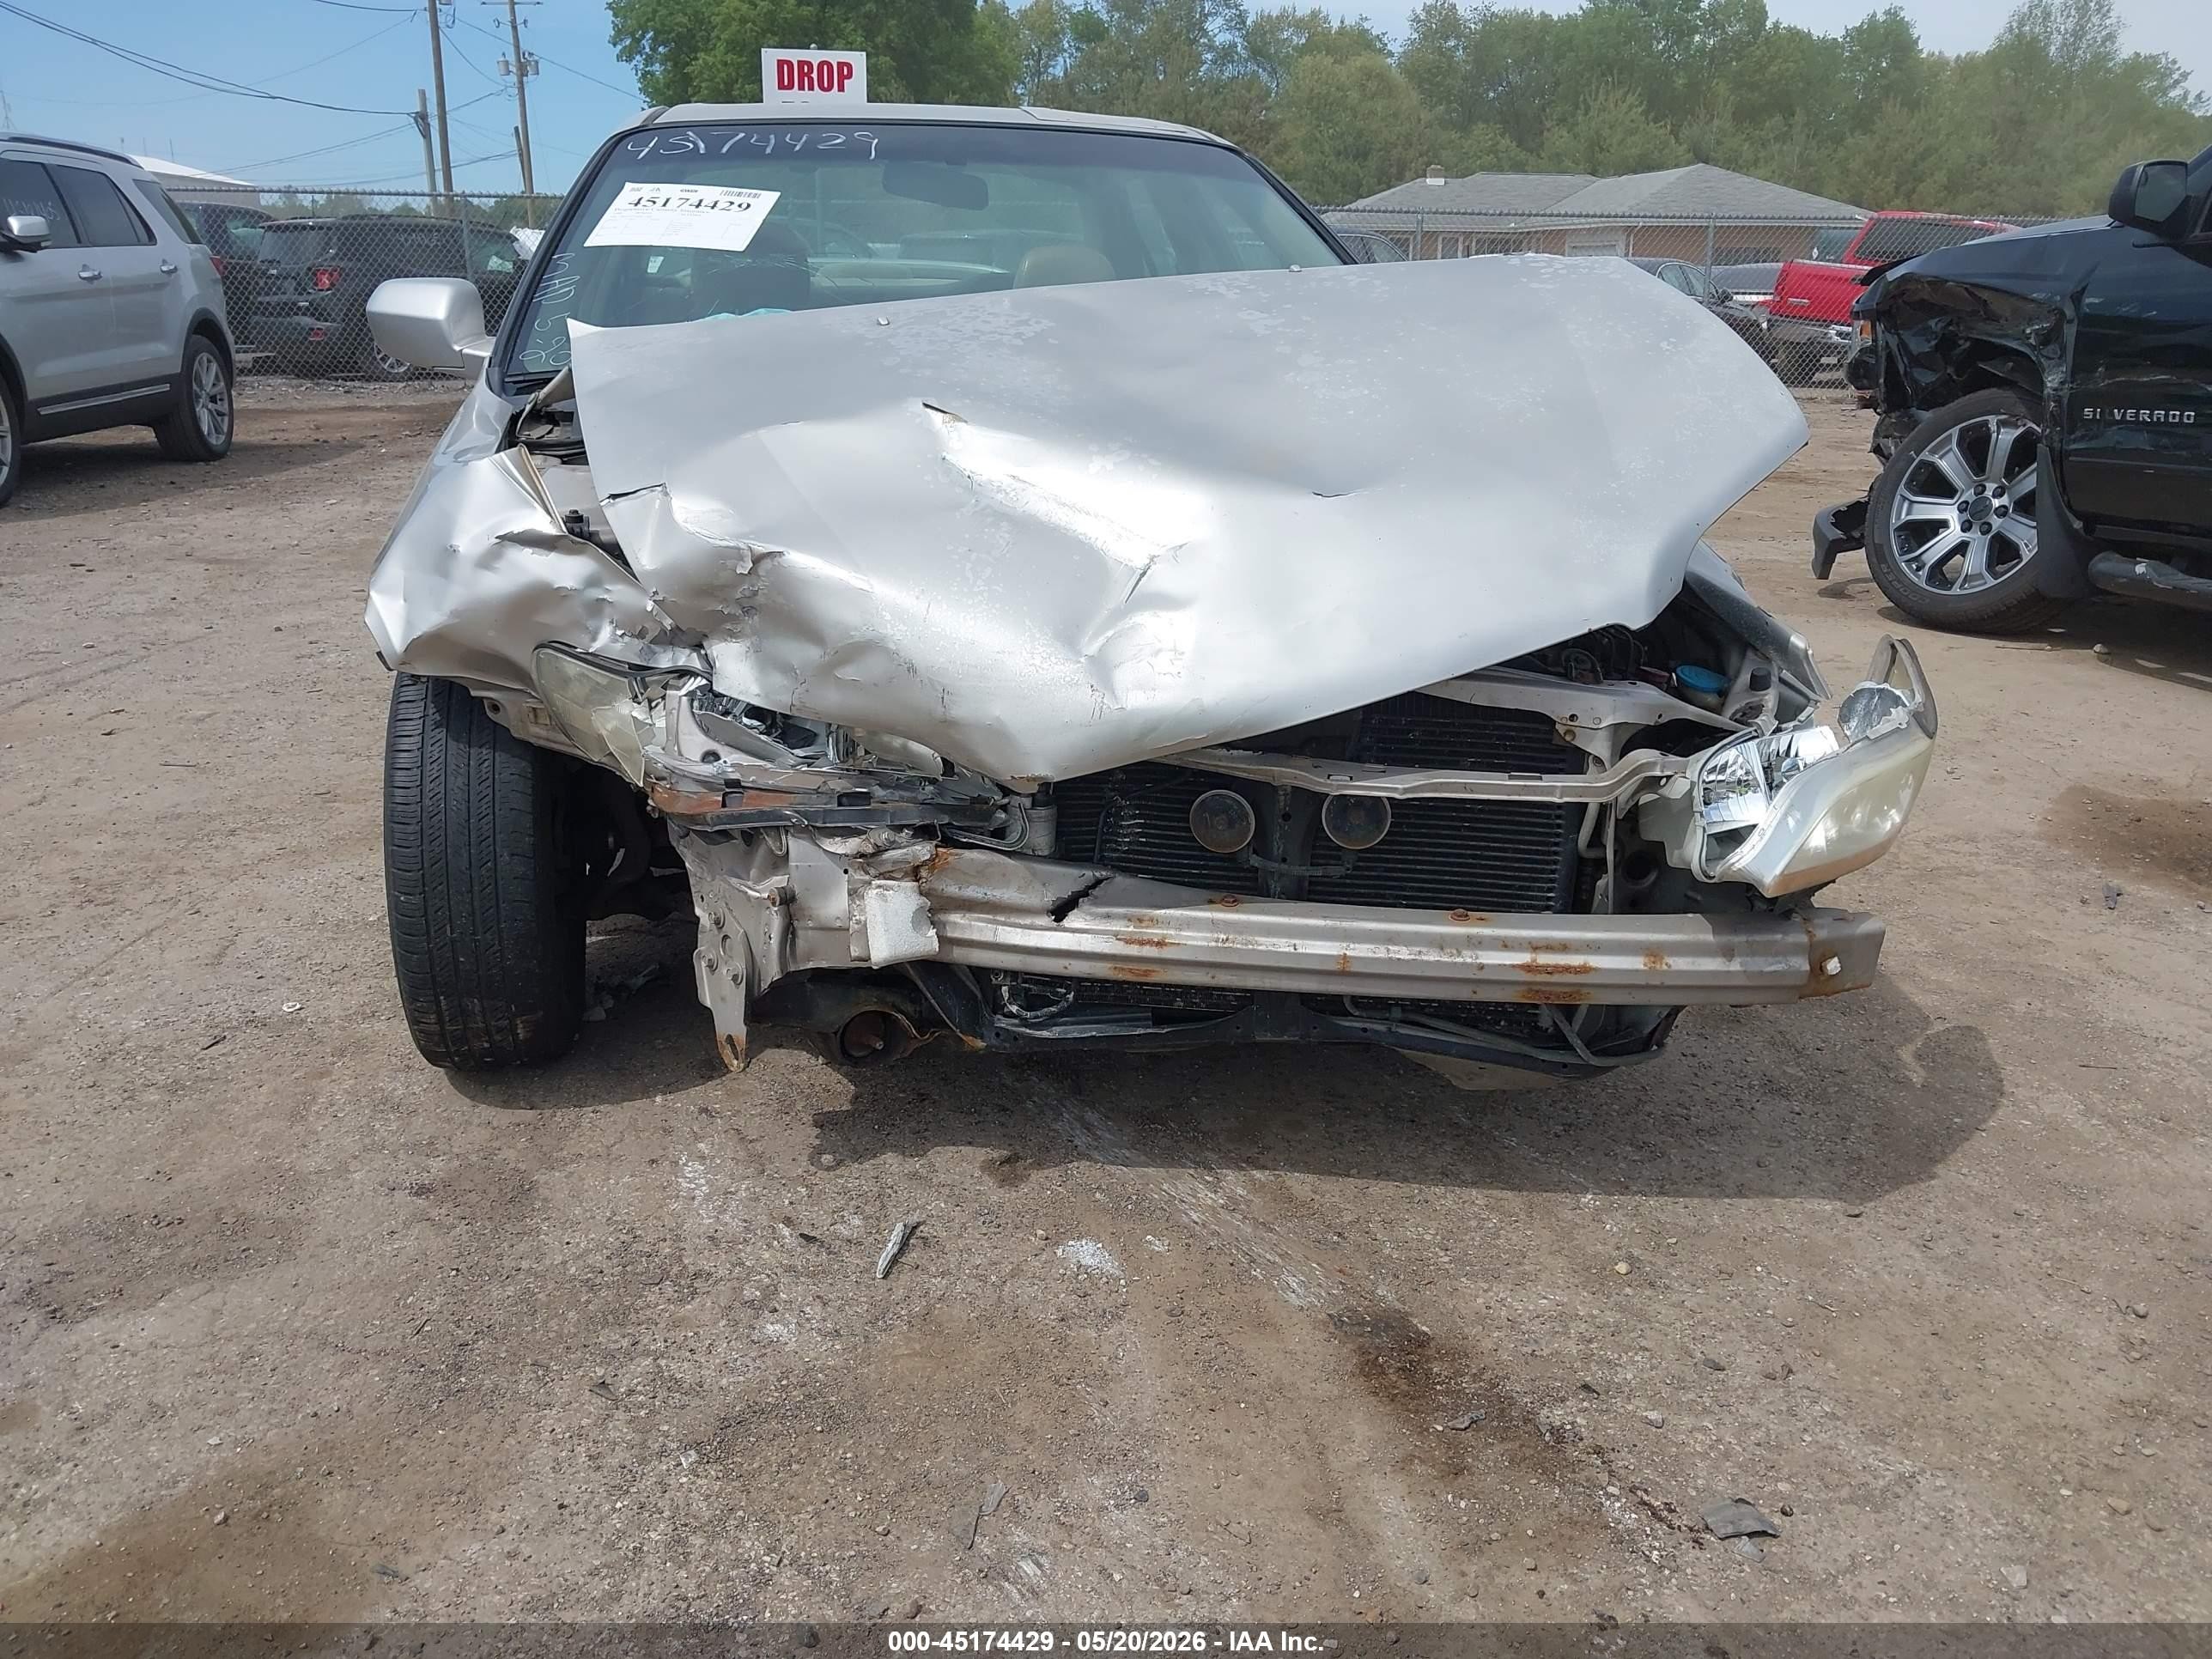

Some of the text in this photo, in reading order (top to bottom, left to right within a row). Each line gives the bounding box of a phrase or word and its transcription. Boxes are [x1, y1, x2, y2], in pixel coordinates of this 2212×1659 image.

[776, 58, 854, 93] DROP
[628, 131, 878, 160] 45174429
[628, 196, 752, 213] 45174429
[1880, 562, 1932, 605] COOPER
